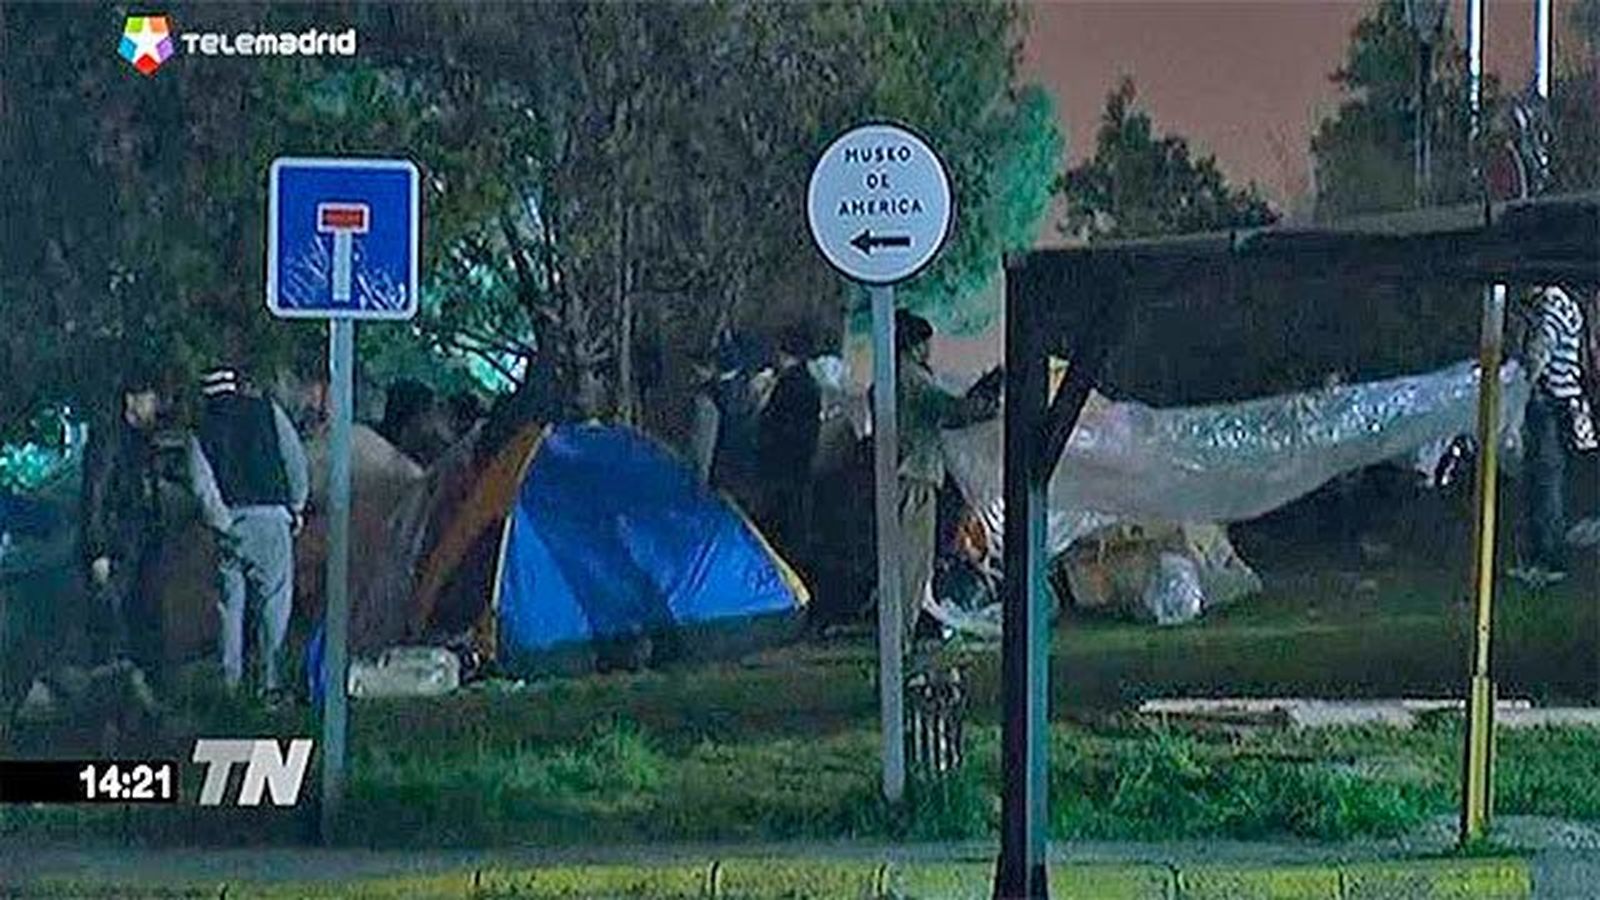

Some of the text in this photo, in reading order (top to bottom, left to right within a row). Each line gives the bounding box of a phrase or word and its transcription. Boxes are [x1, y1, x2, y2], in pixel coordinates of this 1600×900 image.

[845, 146, 911, 163] MUSEO
[866, 173, 890, 189] DE
[838, 199, 923, 216] AMERICA
